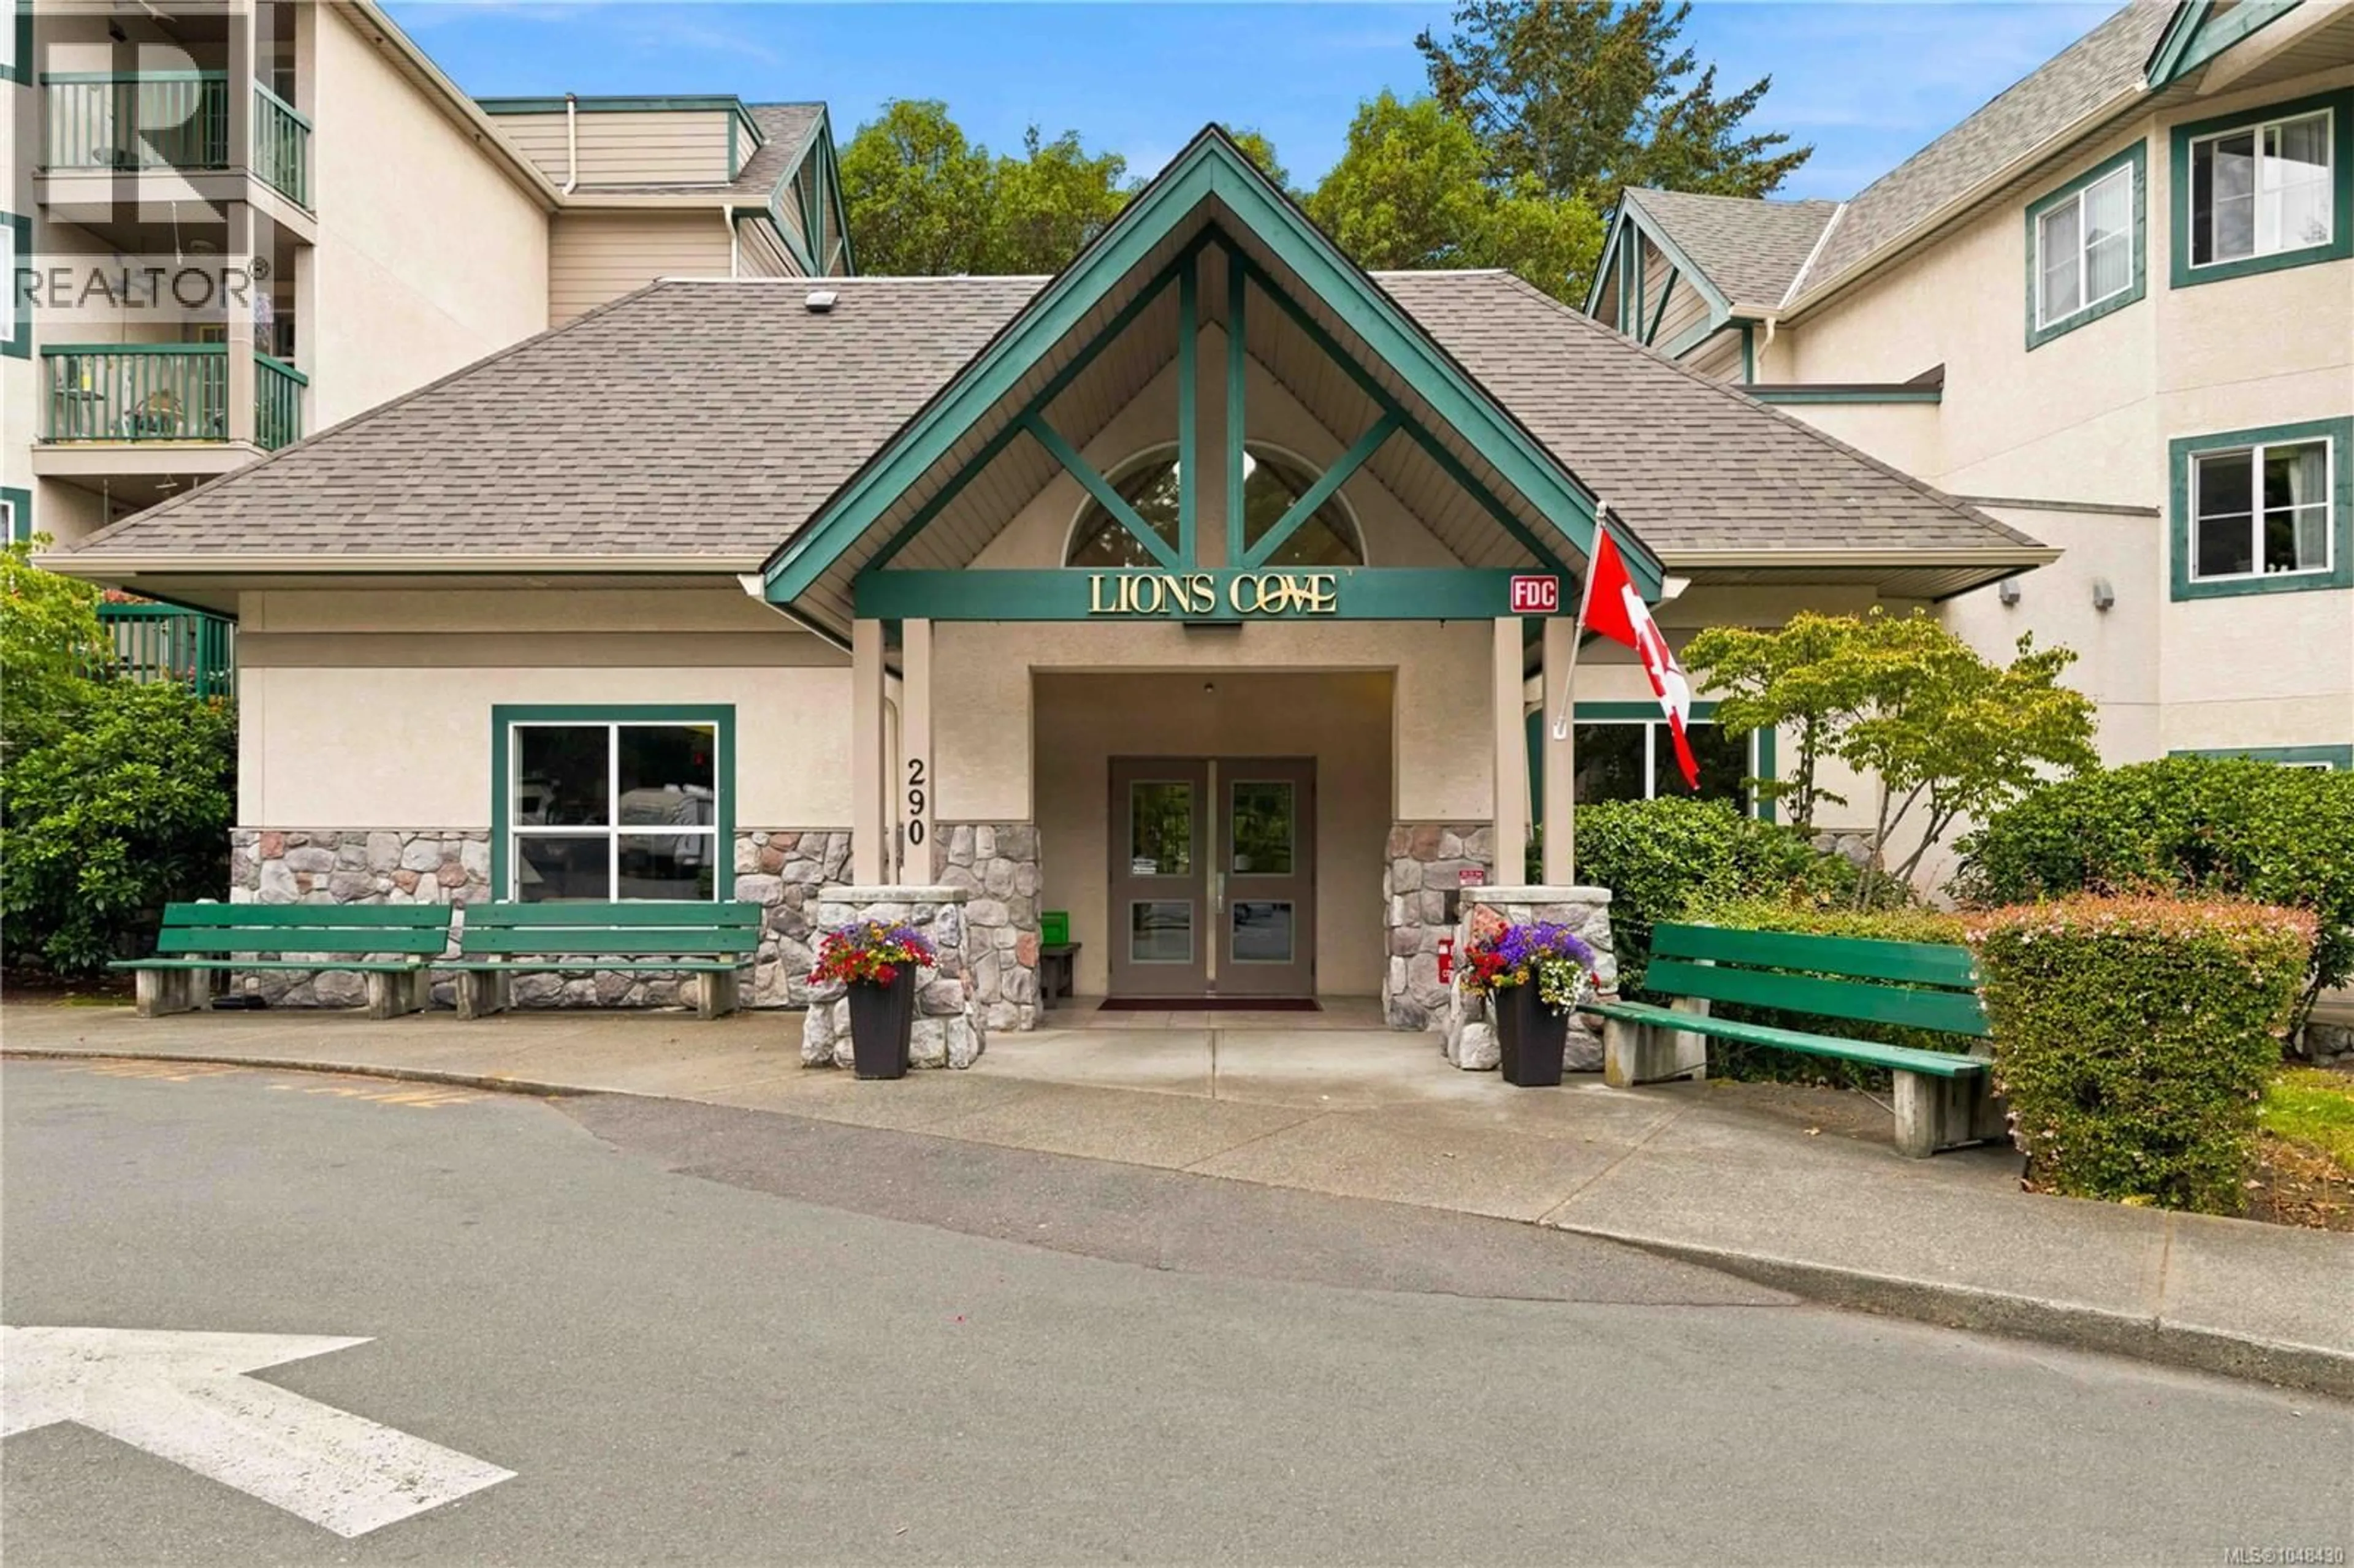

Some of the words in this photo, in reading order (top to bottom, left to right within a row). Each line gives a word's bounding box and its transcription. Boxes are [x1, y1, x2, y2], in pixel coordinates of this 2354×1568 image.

[1088, 573, 1216, 613] LIONS
[1228, 573, 1337, 613] COVE
[1515, 580, 1555, 606] FDC
[907, 758, 926, 845] 290
